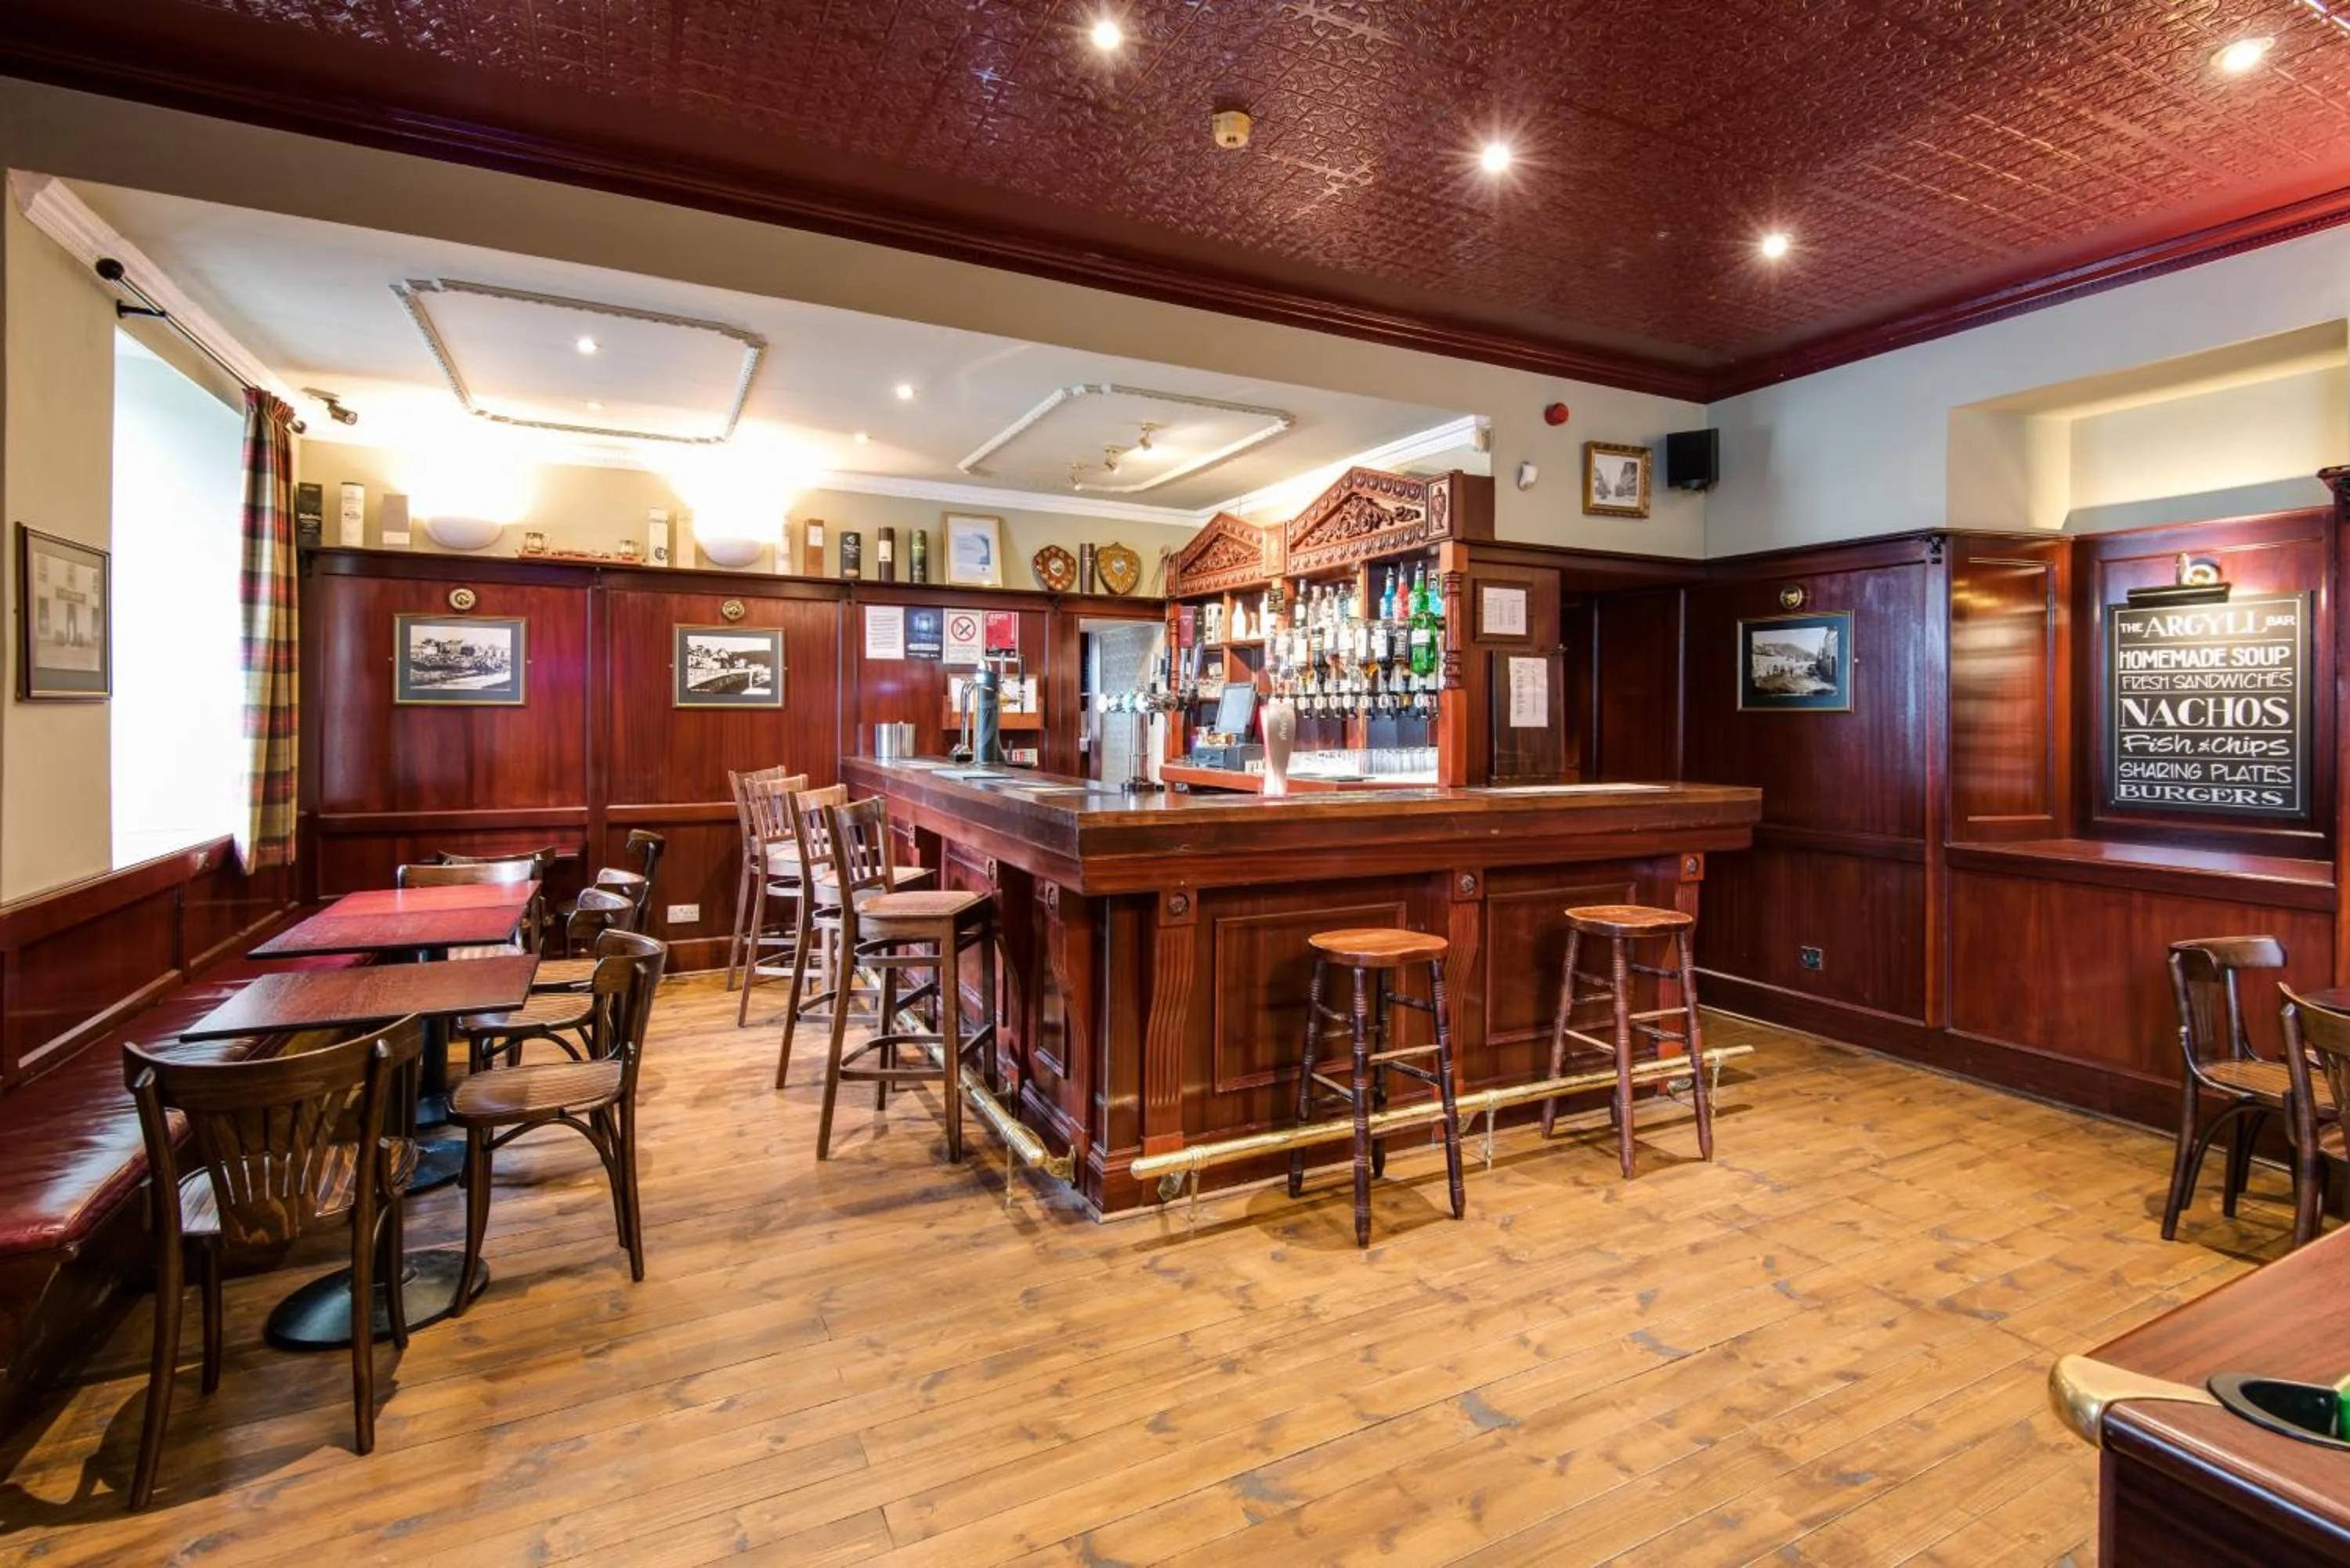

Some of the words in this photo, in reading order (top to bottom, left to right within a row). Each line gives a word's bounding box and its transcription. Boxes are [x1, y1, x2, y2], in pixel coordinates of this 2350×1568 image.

[2119, 622, 2144, 634] THE
[2142, 610, 2268, 638] ARGYLL
[2265, 615, 2297, 627] BAR
[2119, 647, 2227, 670] HOMEMADE
[2230, 645, 2291, 667] SOUP
[2122, 673, 2170, 691] FRESH
[2172, 671, 2294, 691] SANDWICHES
[2119, 696, 2290, 729] NACHOS
[2122, 734, 2194, 755] Fish
[2119, 761, 2203, 781] SHARING
[2209, 763, 2293, 784] PLATES
[2119, 783, 2284, 806] BURGERS
